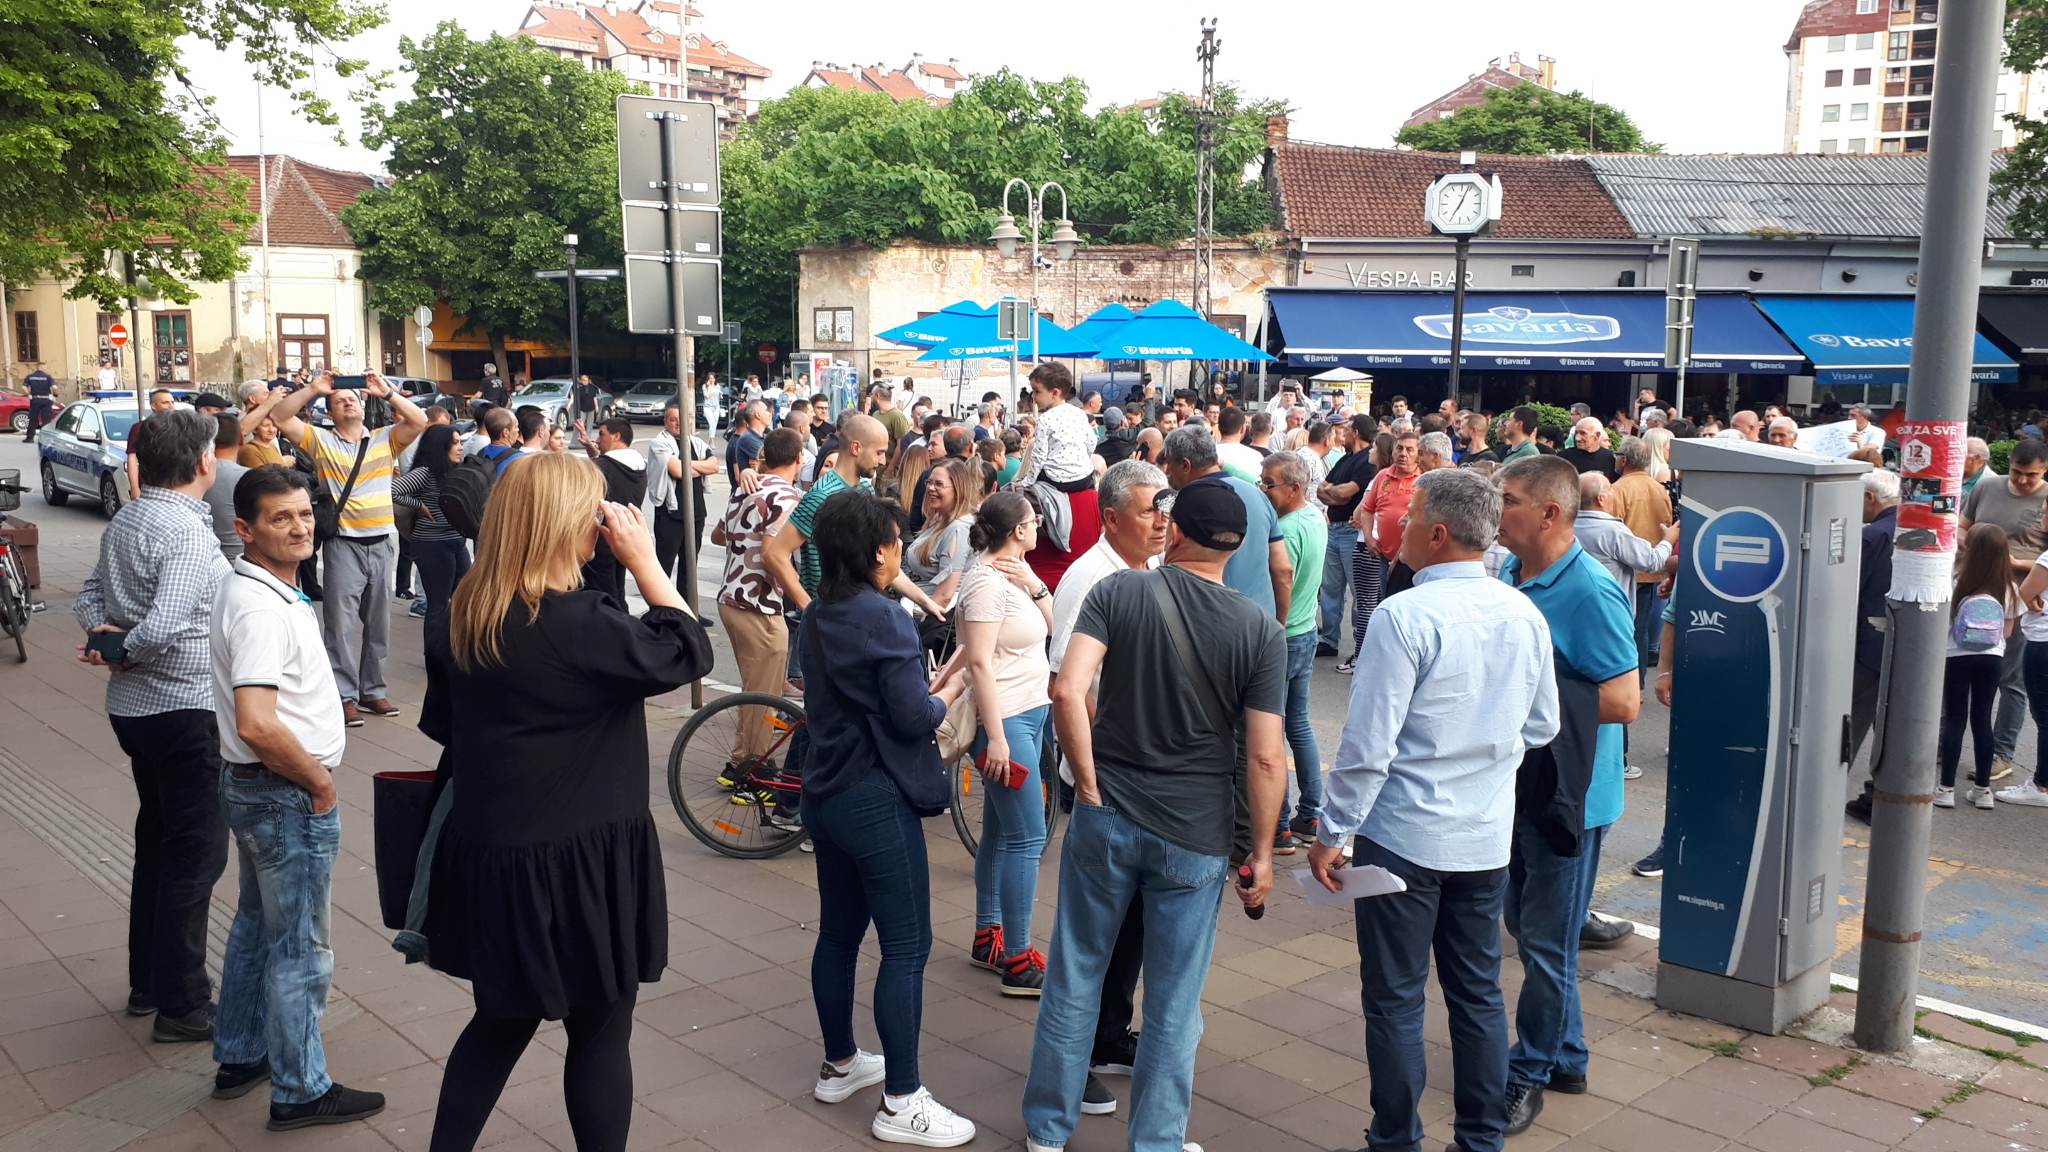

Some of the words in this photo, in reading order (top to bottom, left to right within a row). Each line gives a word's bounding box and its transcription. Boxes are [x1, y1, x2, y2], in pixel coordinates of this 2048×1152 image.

[1346, 262, 1422, 288] VESPA
[1430, 271, 1474, 288] BAR
[1138, 346, 1194, 355] Bavaria
[1310, 354, 1339, 362] Bavaria
[1374, 355, 1402, 364] Bavaria
[1439, 356, 1467, 364] Bavia
[1503, 357, 1531, 365] Bavaria
[1567, 358, 1595, 366] Bavaria
[1631, 359, 1659, 367] Bavaria
[1757, 362, 1785, 370] Bavaria
[1909, 445, 1923, 458] 12
